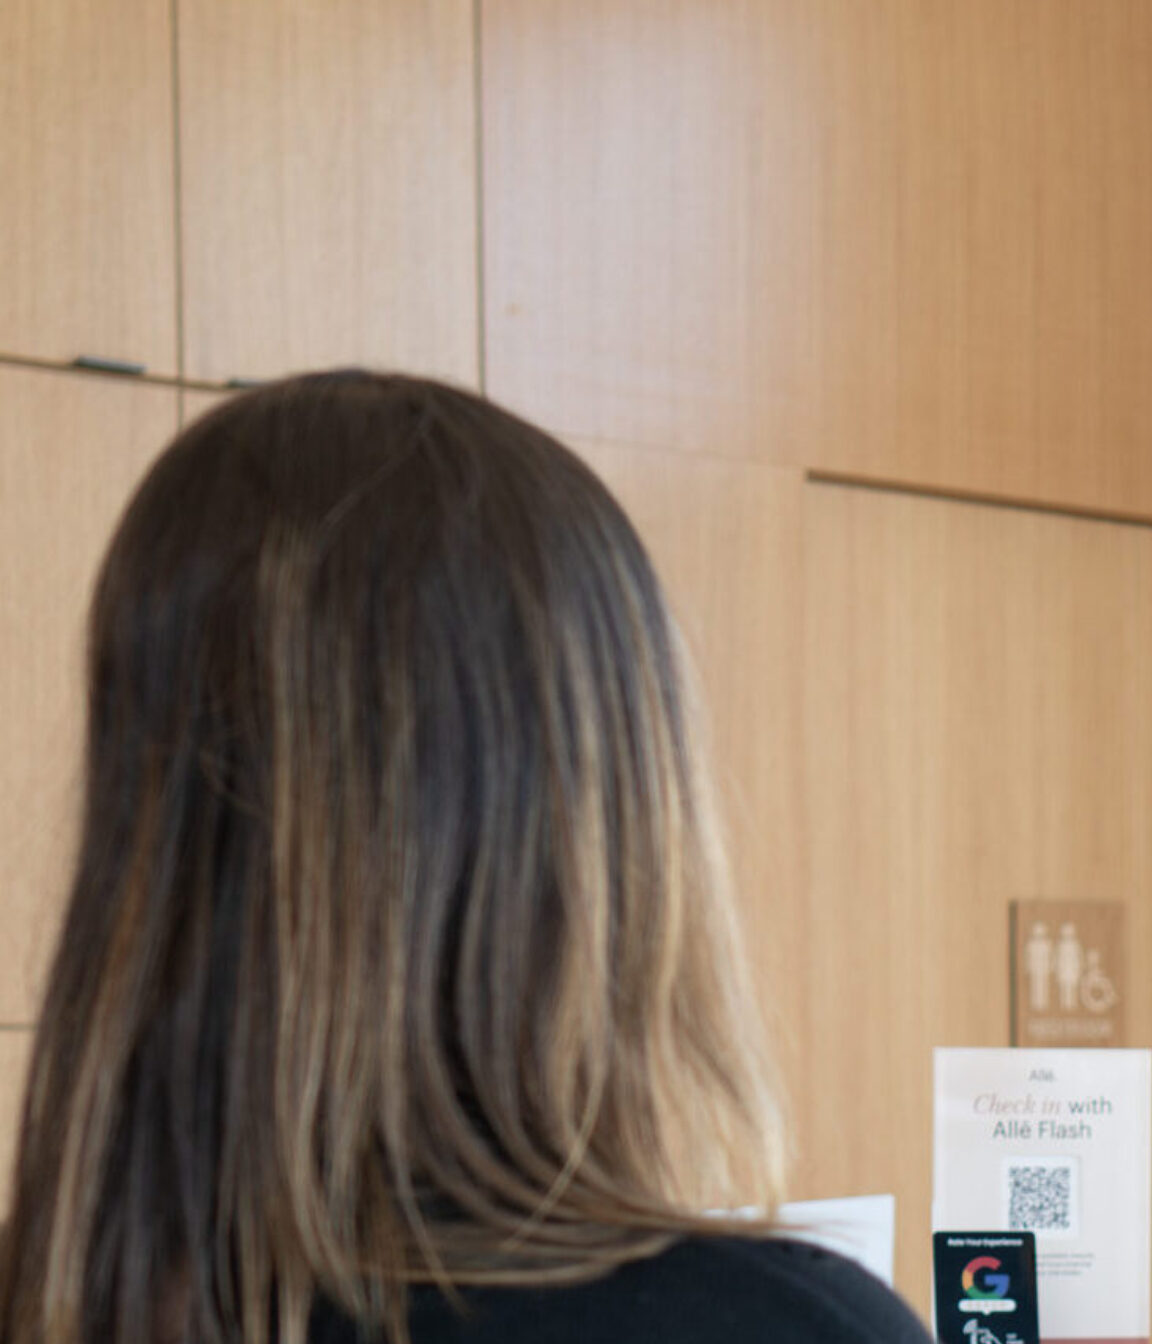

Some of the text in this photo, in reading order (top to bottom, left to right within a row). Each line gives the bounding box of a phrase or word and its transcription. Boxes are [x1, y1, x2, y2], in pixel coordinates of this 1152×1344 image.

[973, 1092, 1113, 1115] Check in with
[1038, 1119, 1092, 1140] Flash
